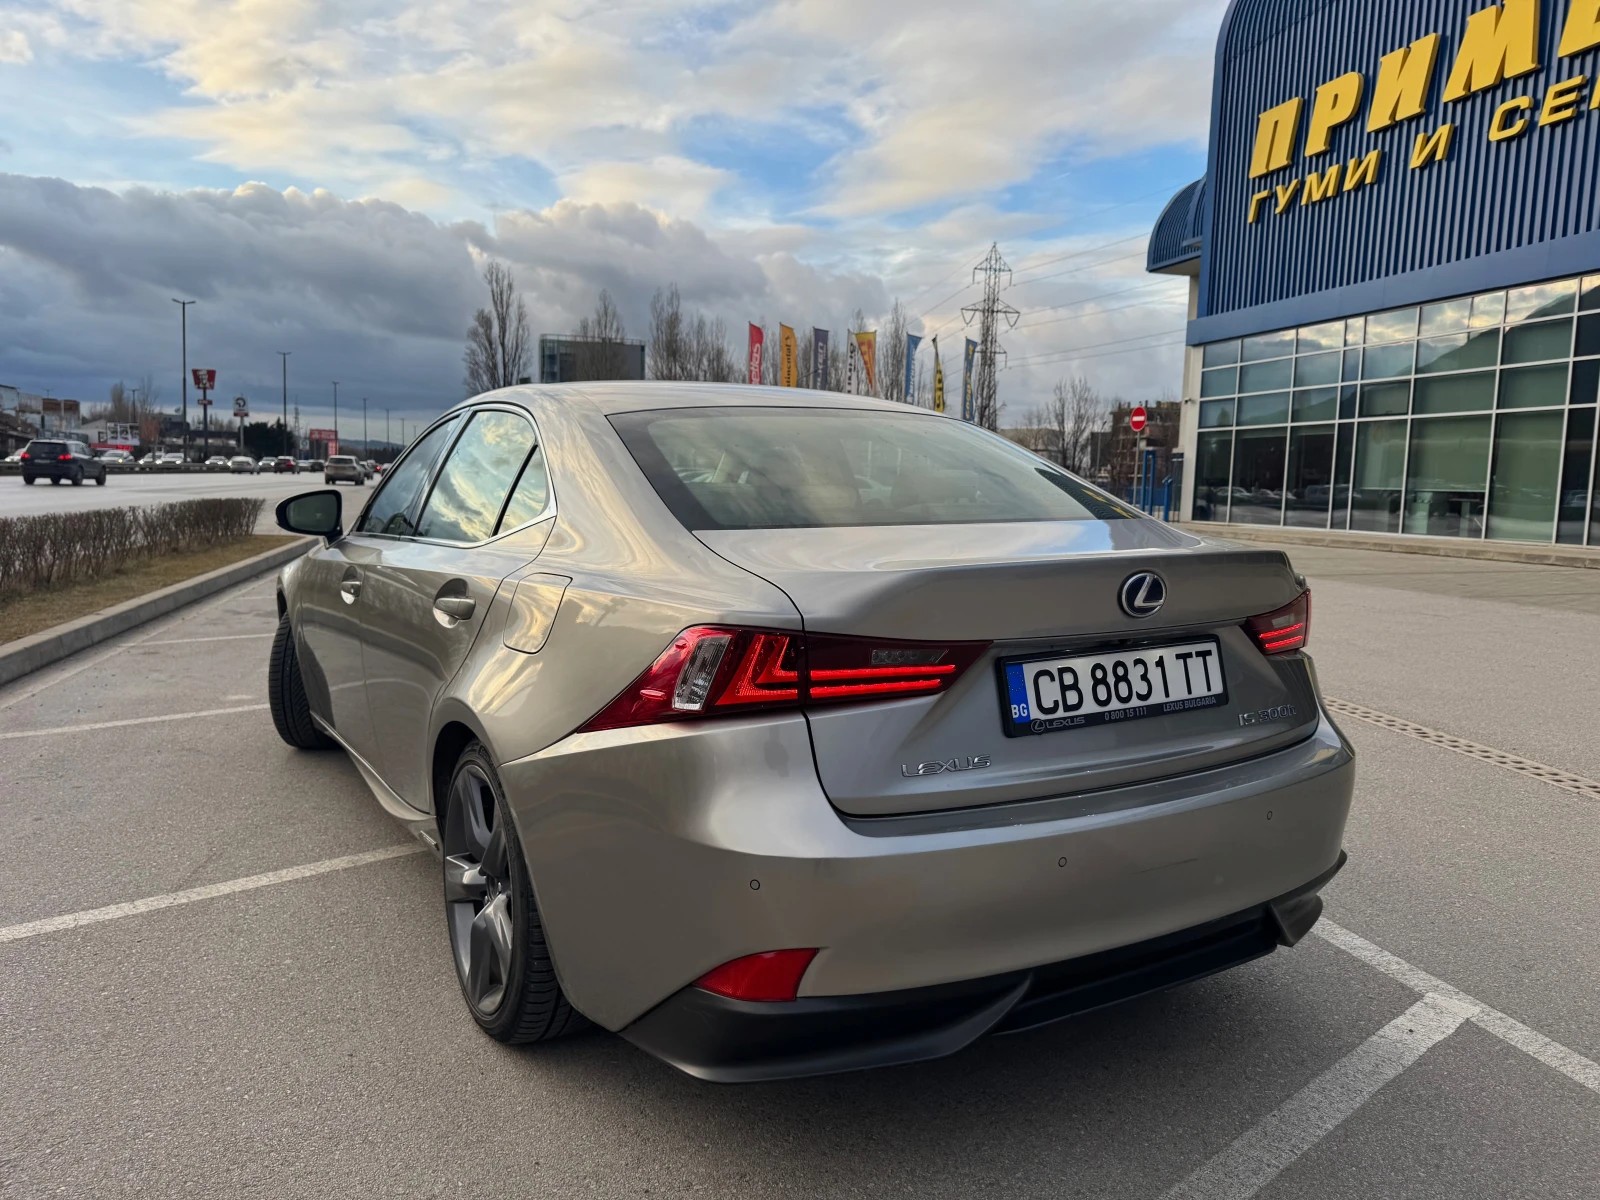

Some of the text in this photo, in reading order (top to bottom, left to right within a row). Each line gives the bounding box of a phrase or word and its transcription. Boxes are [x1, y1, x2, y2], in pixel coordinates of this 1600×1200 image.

[1248, 70, 1600, 224] ГУМИ И СЕ
[1033, 649, 1213, 715] CB 8831 TT
[1011, 702, 1029, 720] BG
[1111, 710, 1125, 721] 800
[1126, 708, 1135, 718] 15
[1136, 706, 1148, 717] 111
[1163, 696, 1217, 712] LEXUS BULGARIA
[1046, 715, 1086, 729] LEXUS
[1238, 704, 1297, 726] IS 300h
[901, 754, 992, 777] LEXUS
